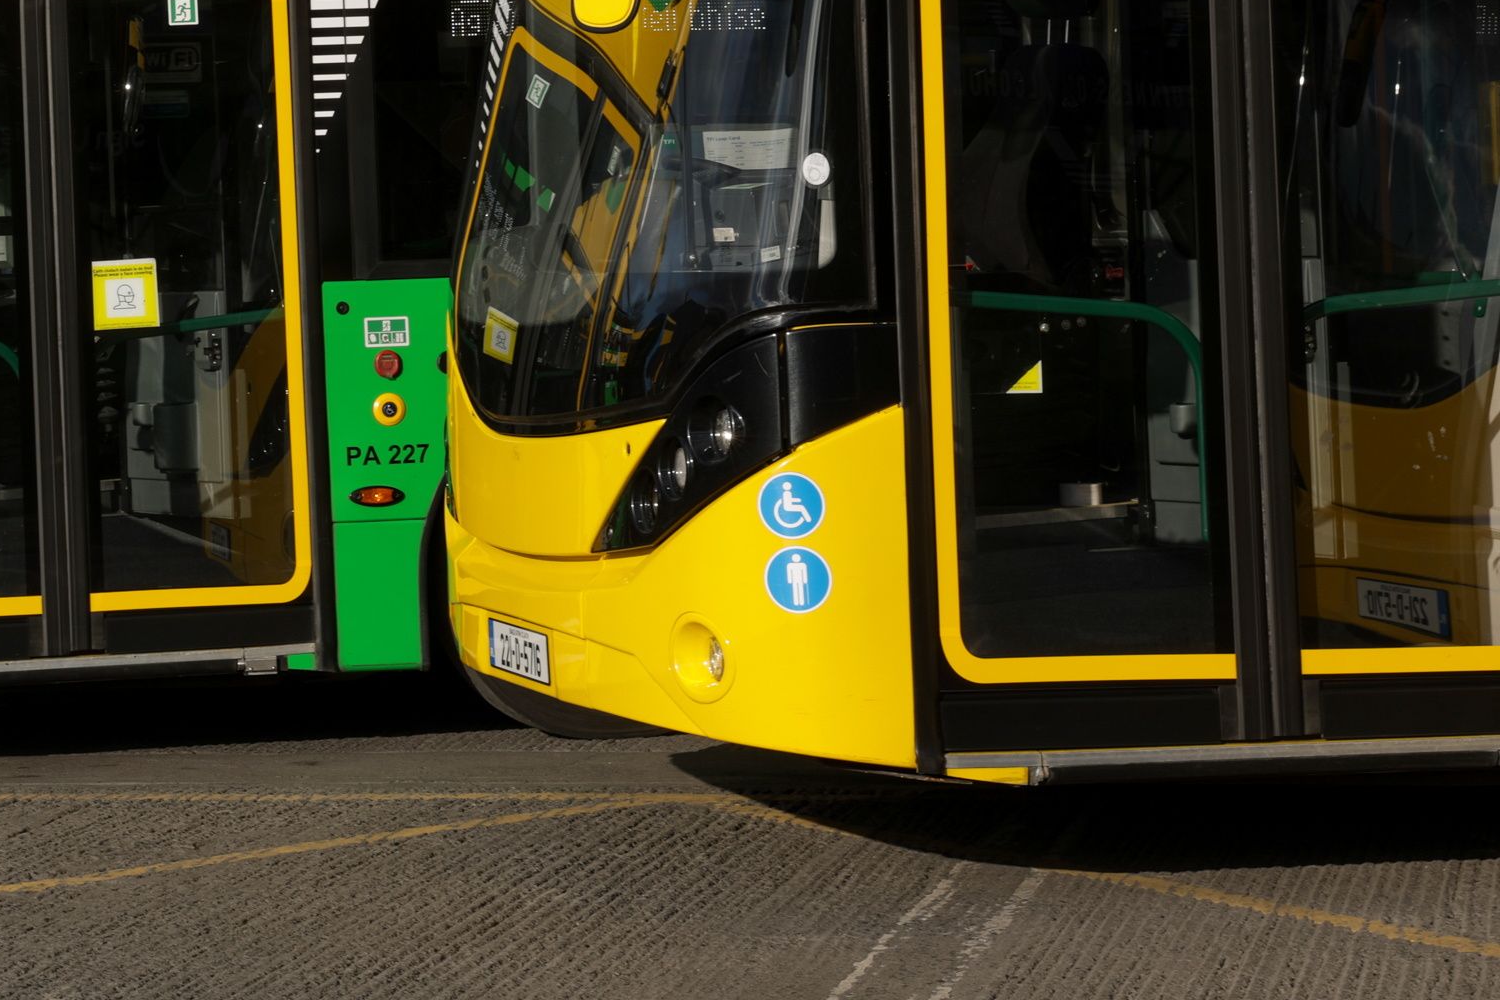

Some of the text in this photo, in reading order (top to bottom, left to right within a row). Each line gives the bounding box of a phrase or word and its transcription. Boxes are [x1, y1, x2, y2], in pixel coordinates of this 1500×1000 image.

[346, 444, 430, 466] PA 227
[500, 634, 541, 677] 221-D-5716
